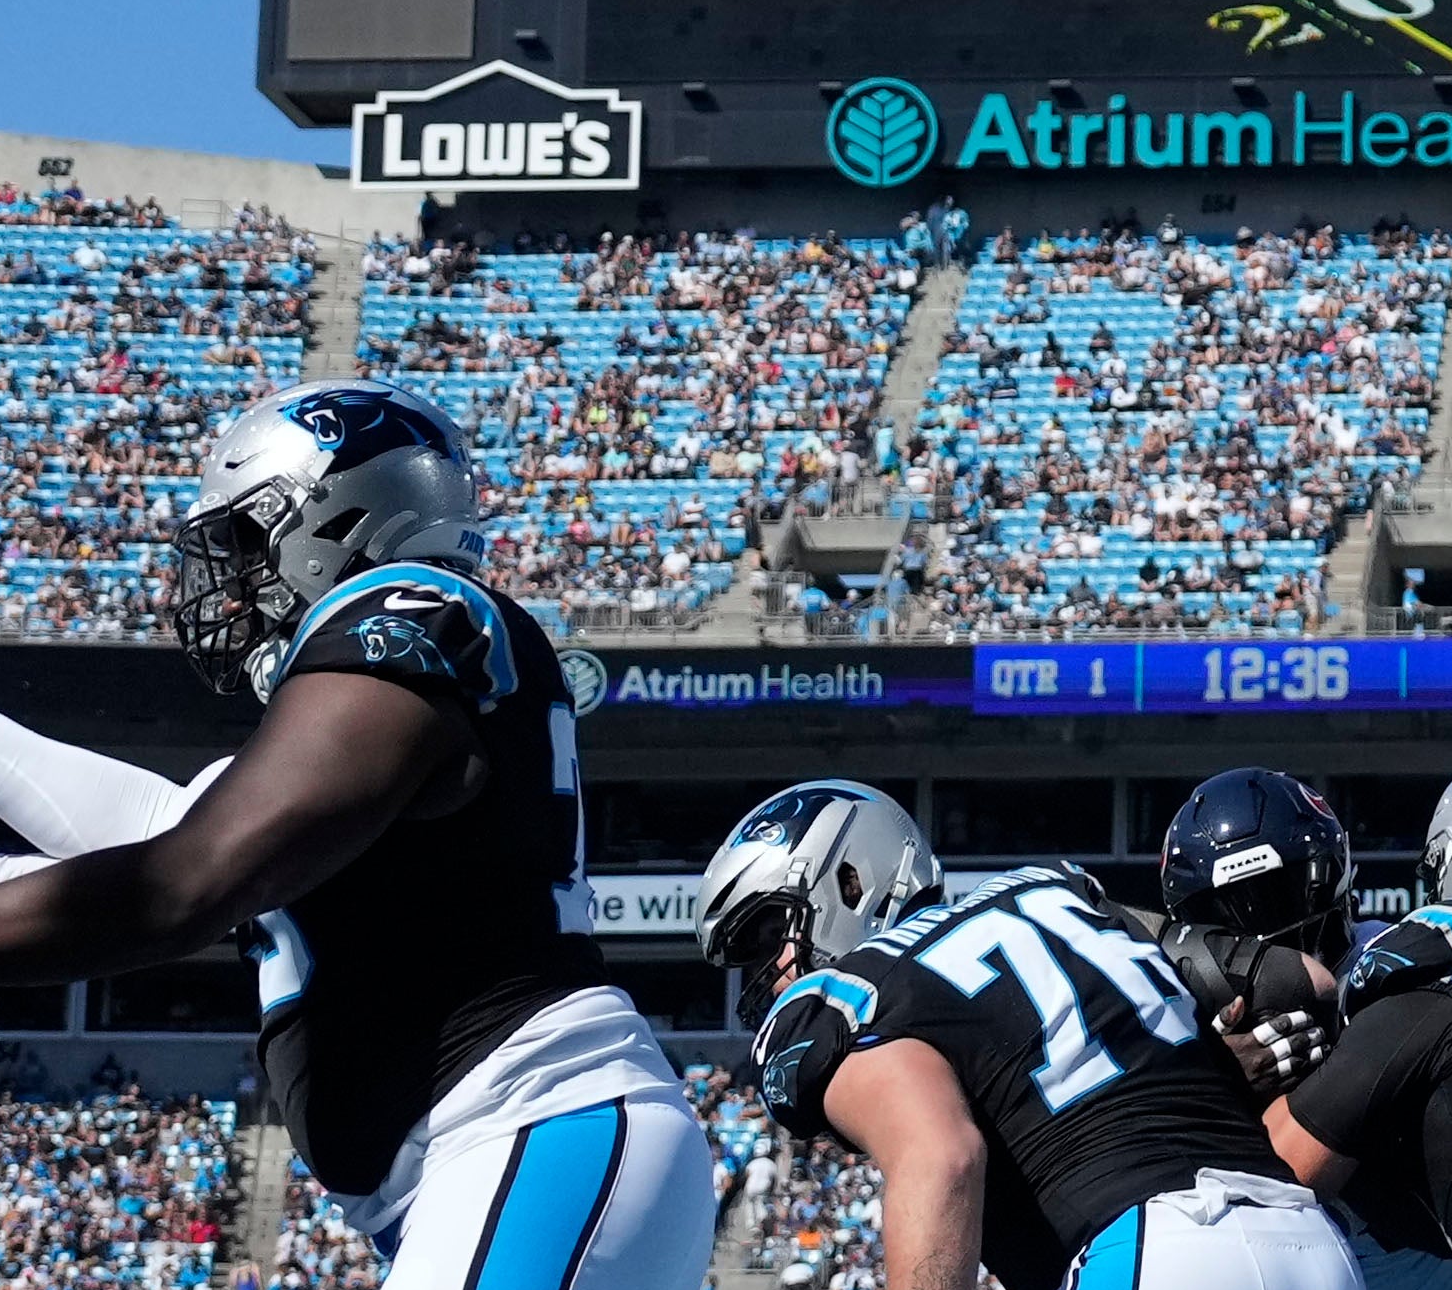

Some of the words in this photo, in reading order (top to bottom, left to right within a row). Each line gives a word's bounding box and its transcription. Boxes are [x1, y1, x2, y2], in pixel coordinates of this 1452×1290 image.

[382, 111, 611, 179] LOWE'S
[957, 92, 1272, 169] Atrium
[617, 663, 754, 703] Atrium
[760, 661, 884, 700] Health
[991, 658, 1059, 699] QTR
[1089, 657, 1107, 697] 1
[1203, 646, 1350, 703] 12:36
[1220, 853, 1269, 872] TEXANS
[913, 885, 1199, 1117] 76
